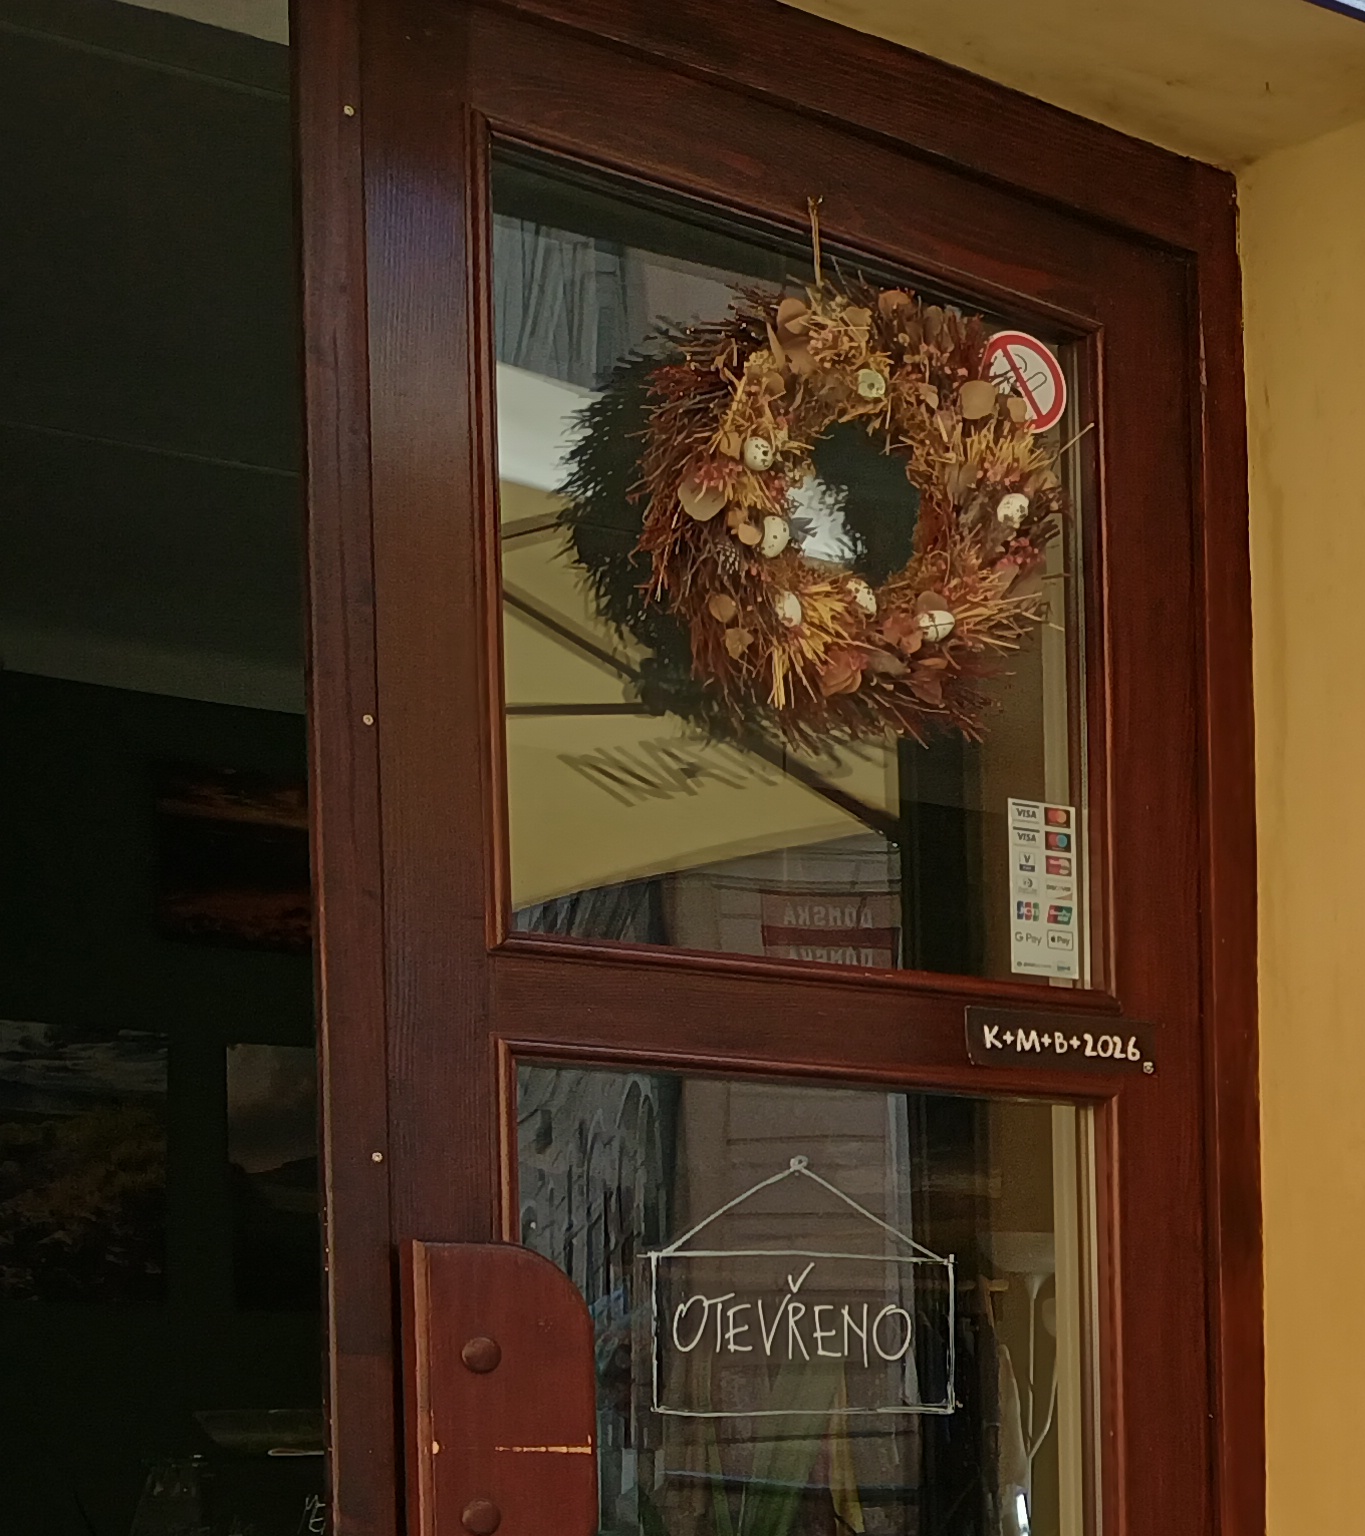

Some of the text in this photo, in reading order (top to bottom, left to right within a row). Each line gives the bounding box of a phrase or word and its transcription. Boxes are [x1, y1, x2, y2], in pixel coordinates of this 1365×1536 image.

[1015, 808, 1037, 819] VISA
[1017, 832, 1037, 843] VISA
[1014, 931, 1042, 947] G Pay
[1056, 935, 1070, 947] Pay
[983, 1024, 1141, 1061] K+M+B+2026
[673, 1262, 912, 1368] OTEVŘENO
